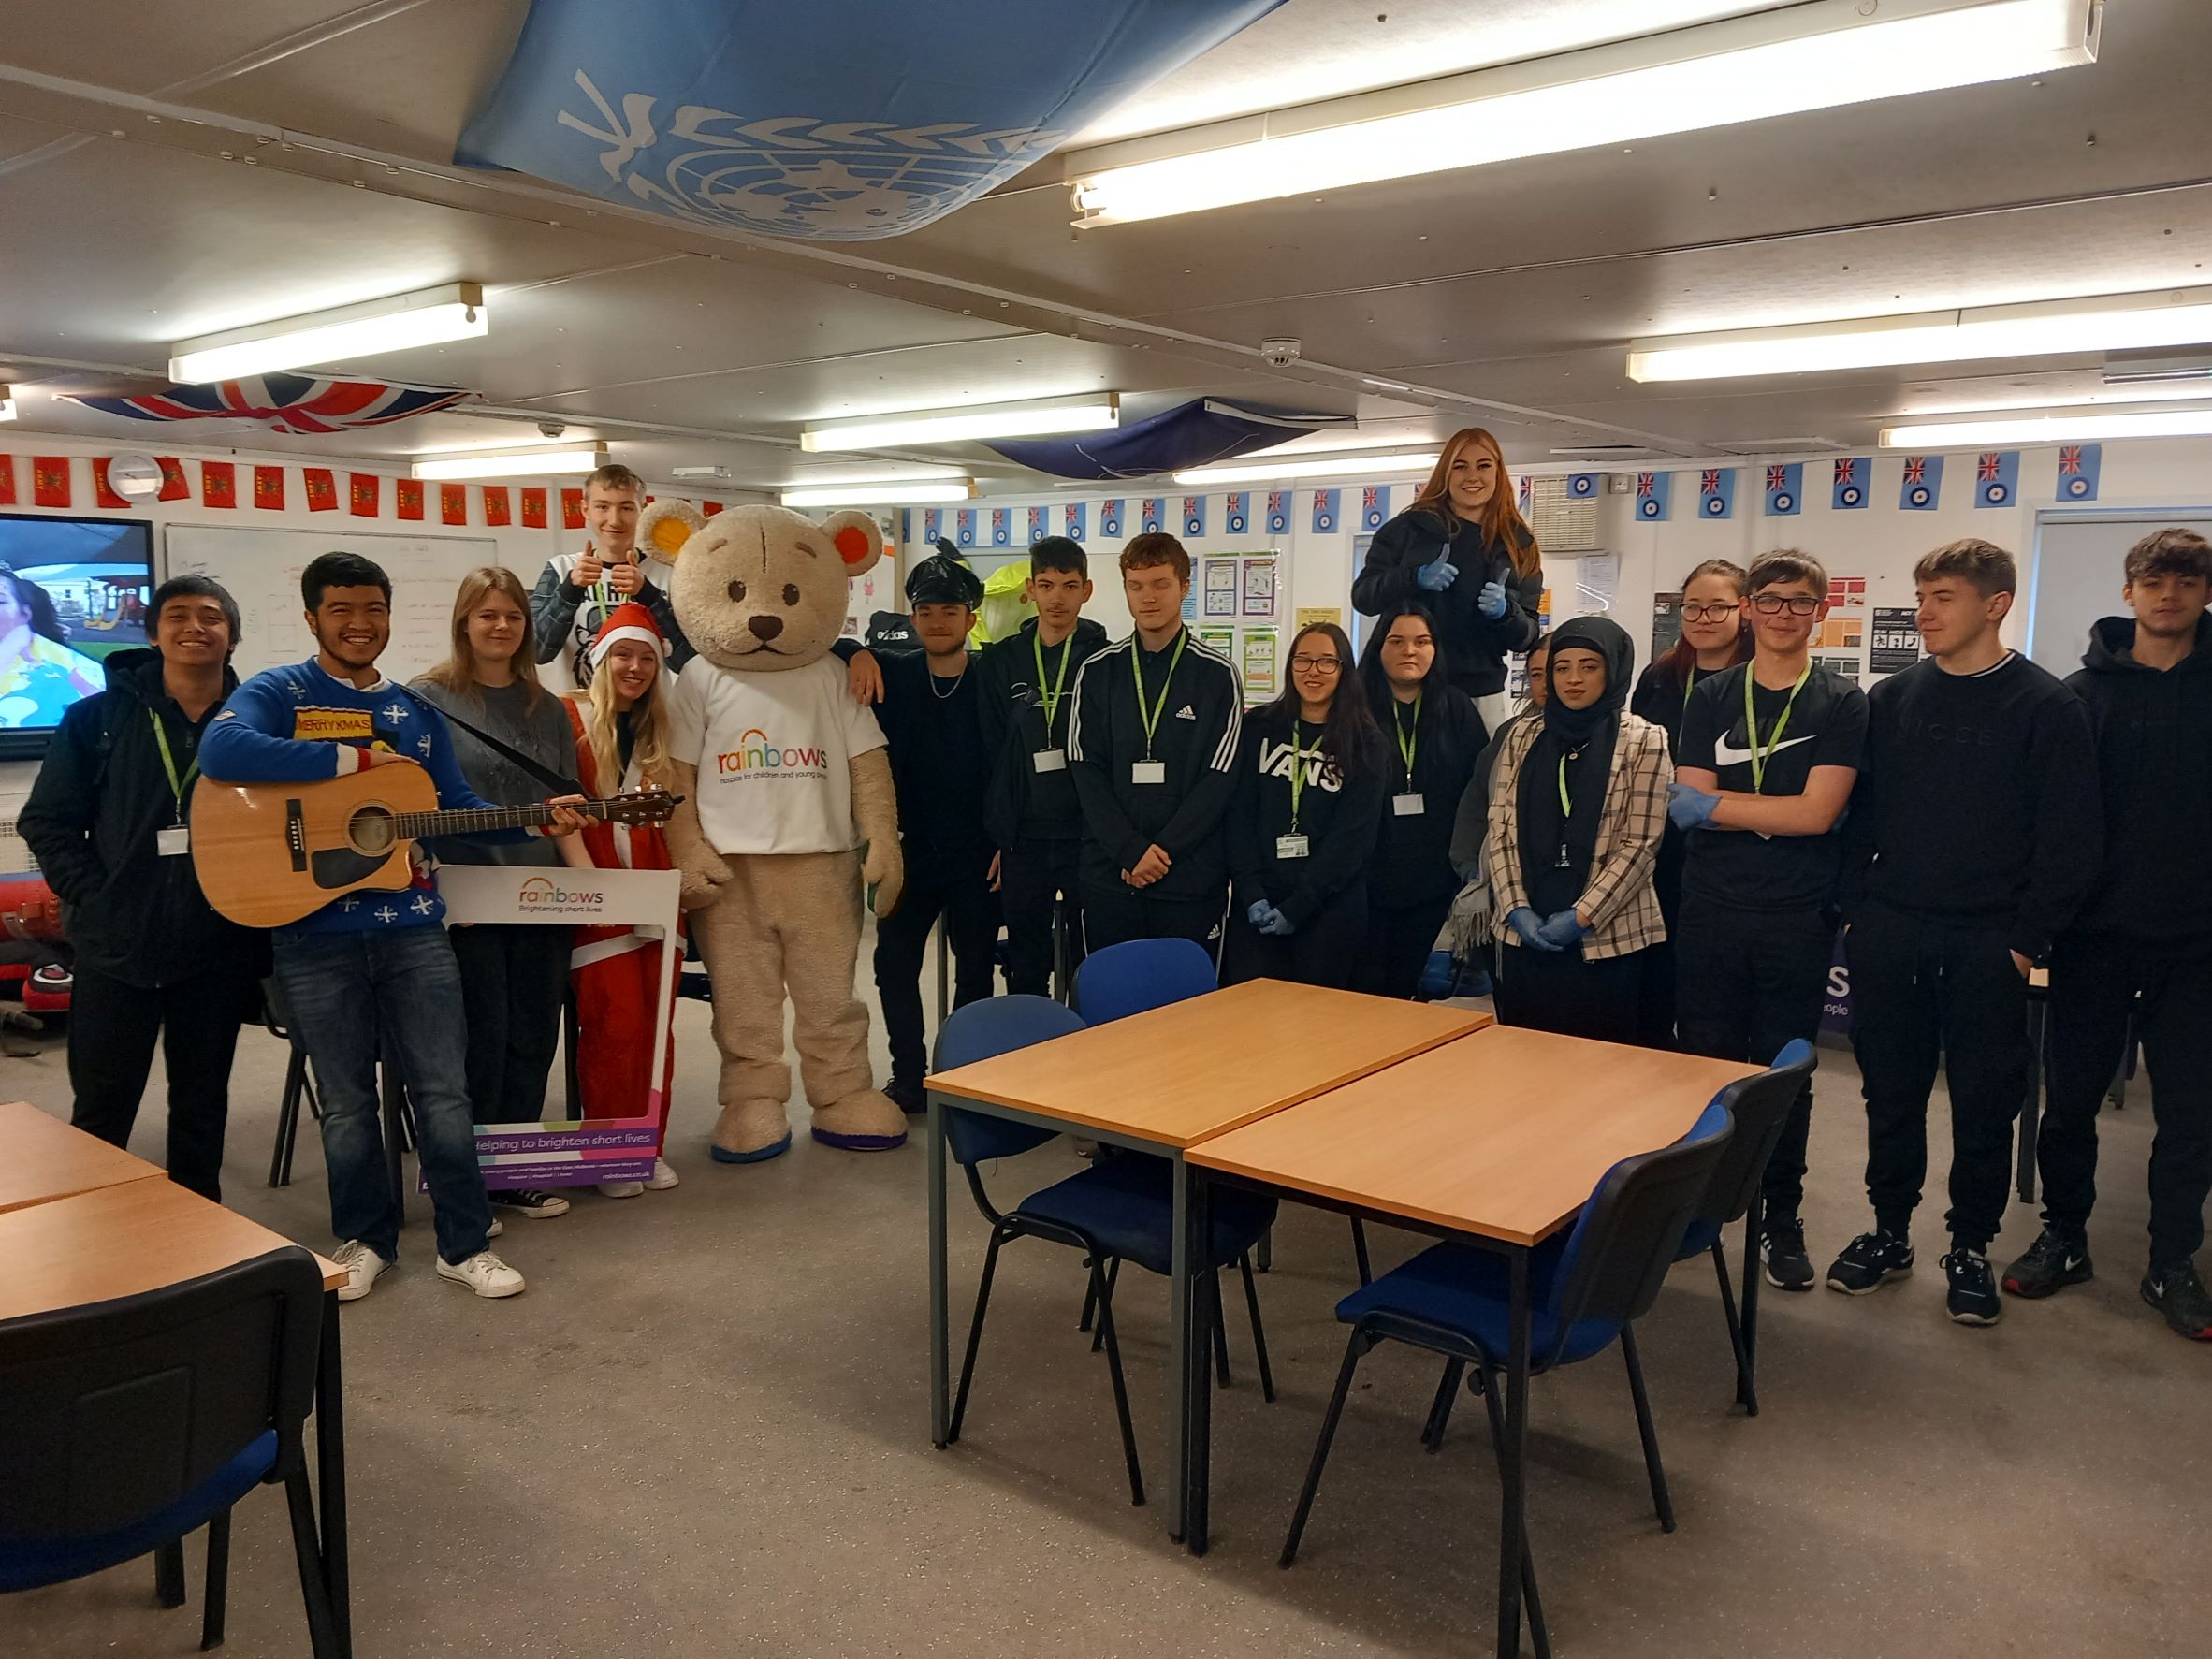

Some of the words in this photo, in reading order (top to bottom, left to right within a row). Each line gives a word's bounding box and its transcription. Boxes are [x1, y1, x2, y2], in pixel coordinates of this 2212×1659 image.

[36, 469, 45, 490] ARMY
[717, 739, 827, 774] rainbows
[1258, 737, 1345, 793] VANS
[518, 886, 604, 904] rainbows
[522, 1139, 535, 1149] to
[537, 1135, 589, 1149] brighten
[591, 1133, 622, 1145] short
[624, 1133, 651, 1143] lives
